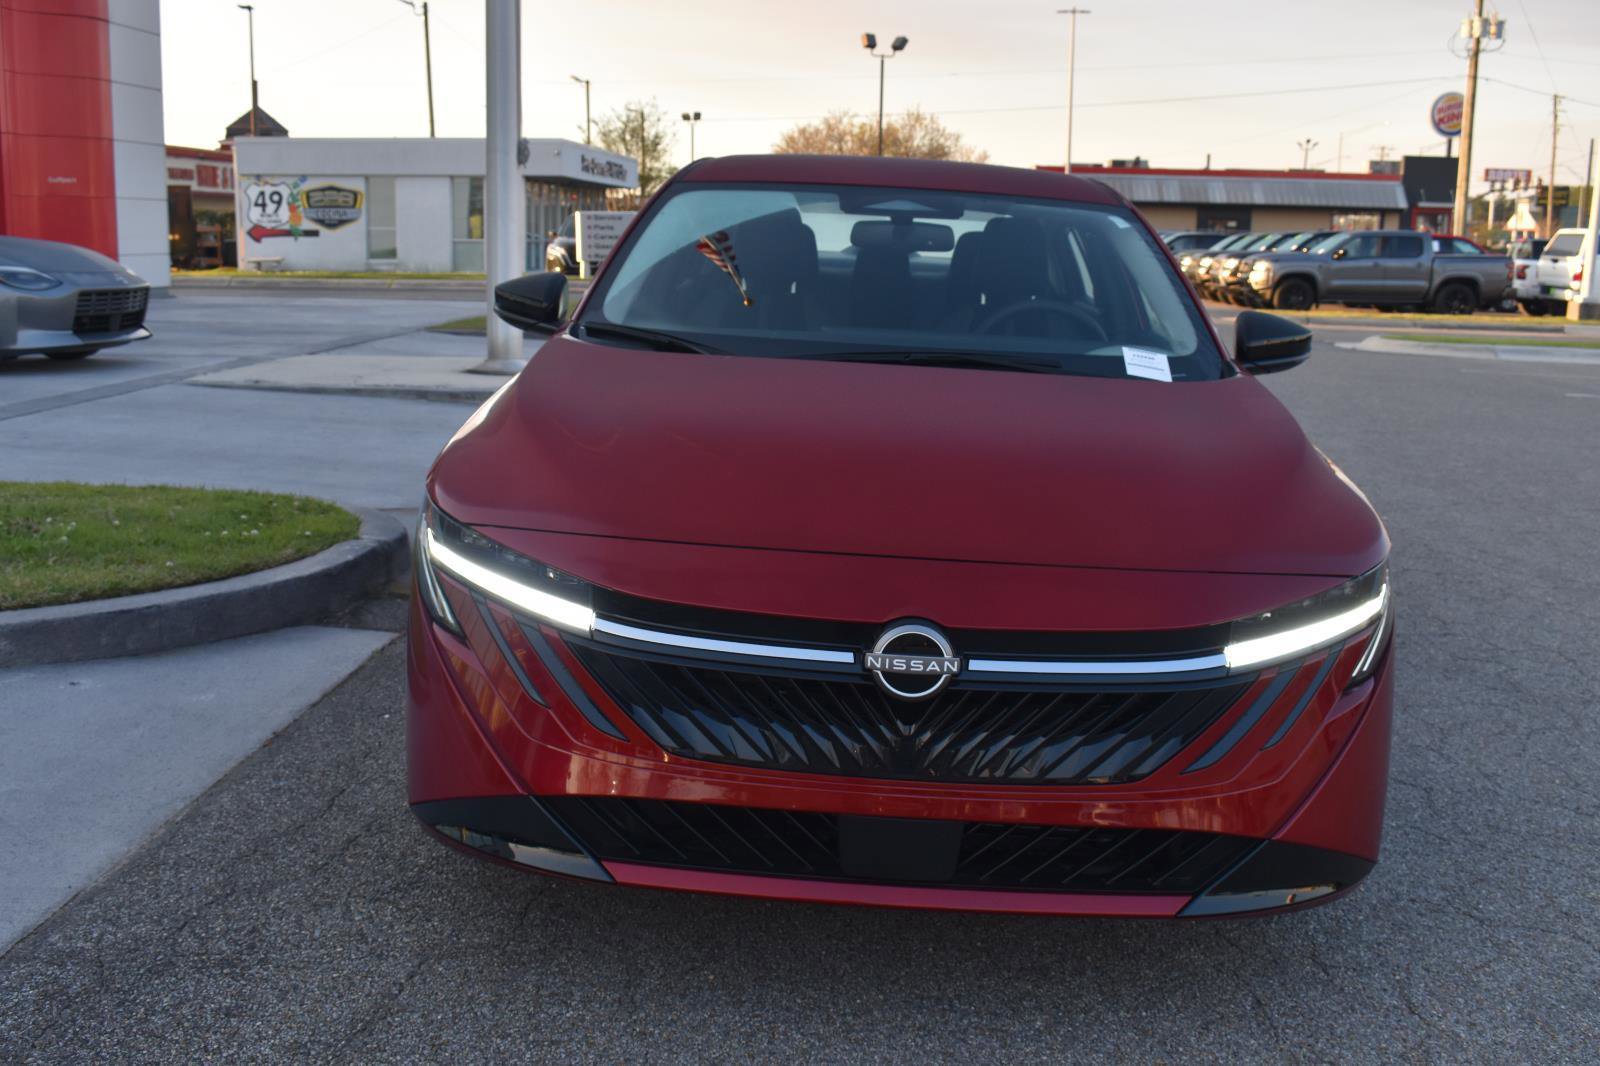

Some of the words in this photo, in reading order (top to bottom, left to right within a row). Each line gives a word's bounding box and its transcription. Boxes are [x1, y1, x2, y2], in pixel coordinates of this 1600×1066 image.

[1437, 112, 1462, 126] KIN
[254, 190, 283, 214] 49
[867, 655, 958, 672] NISSAN
